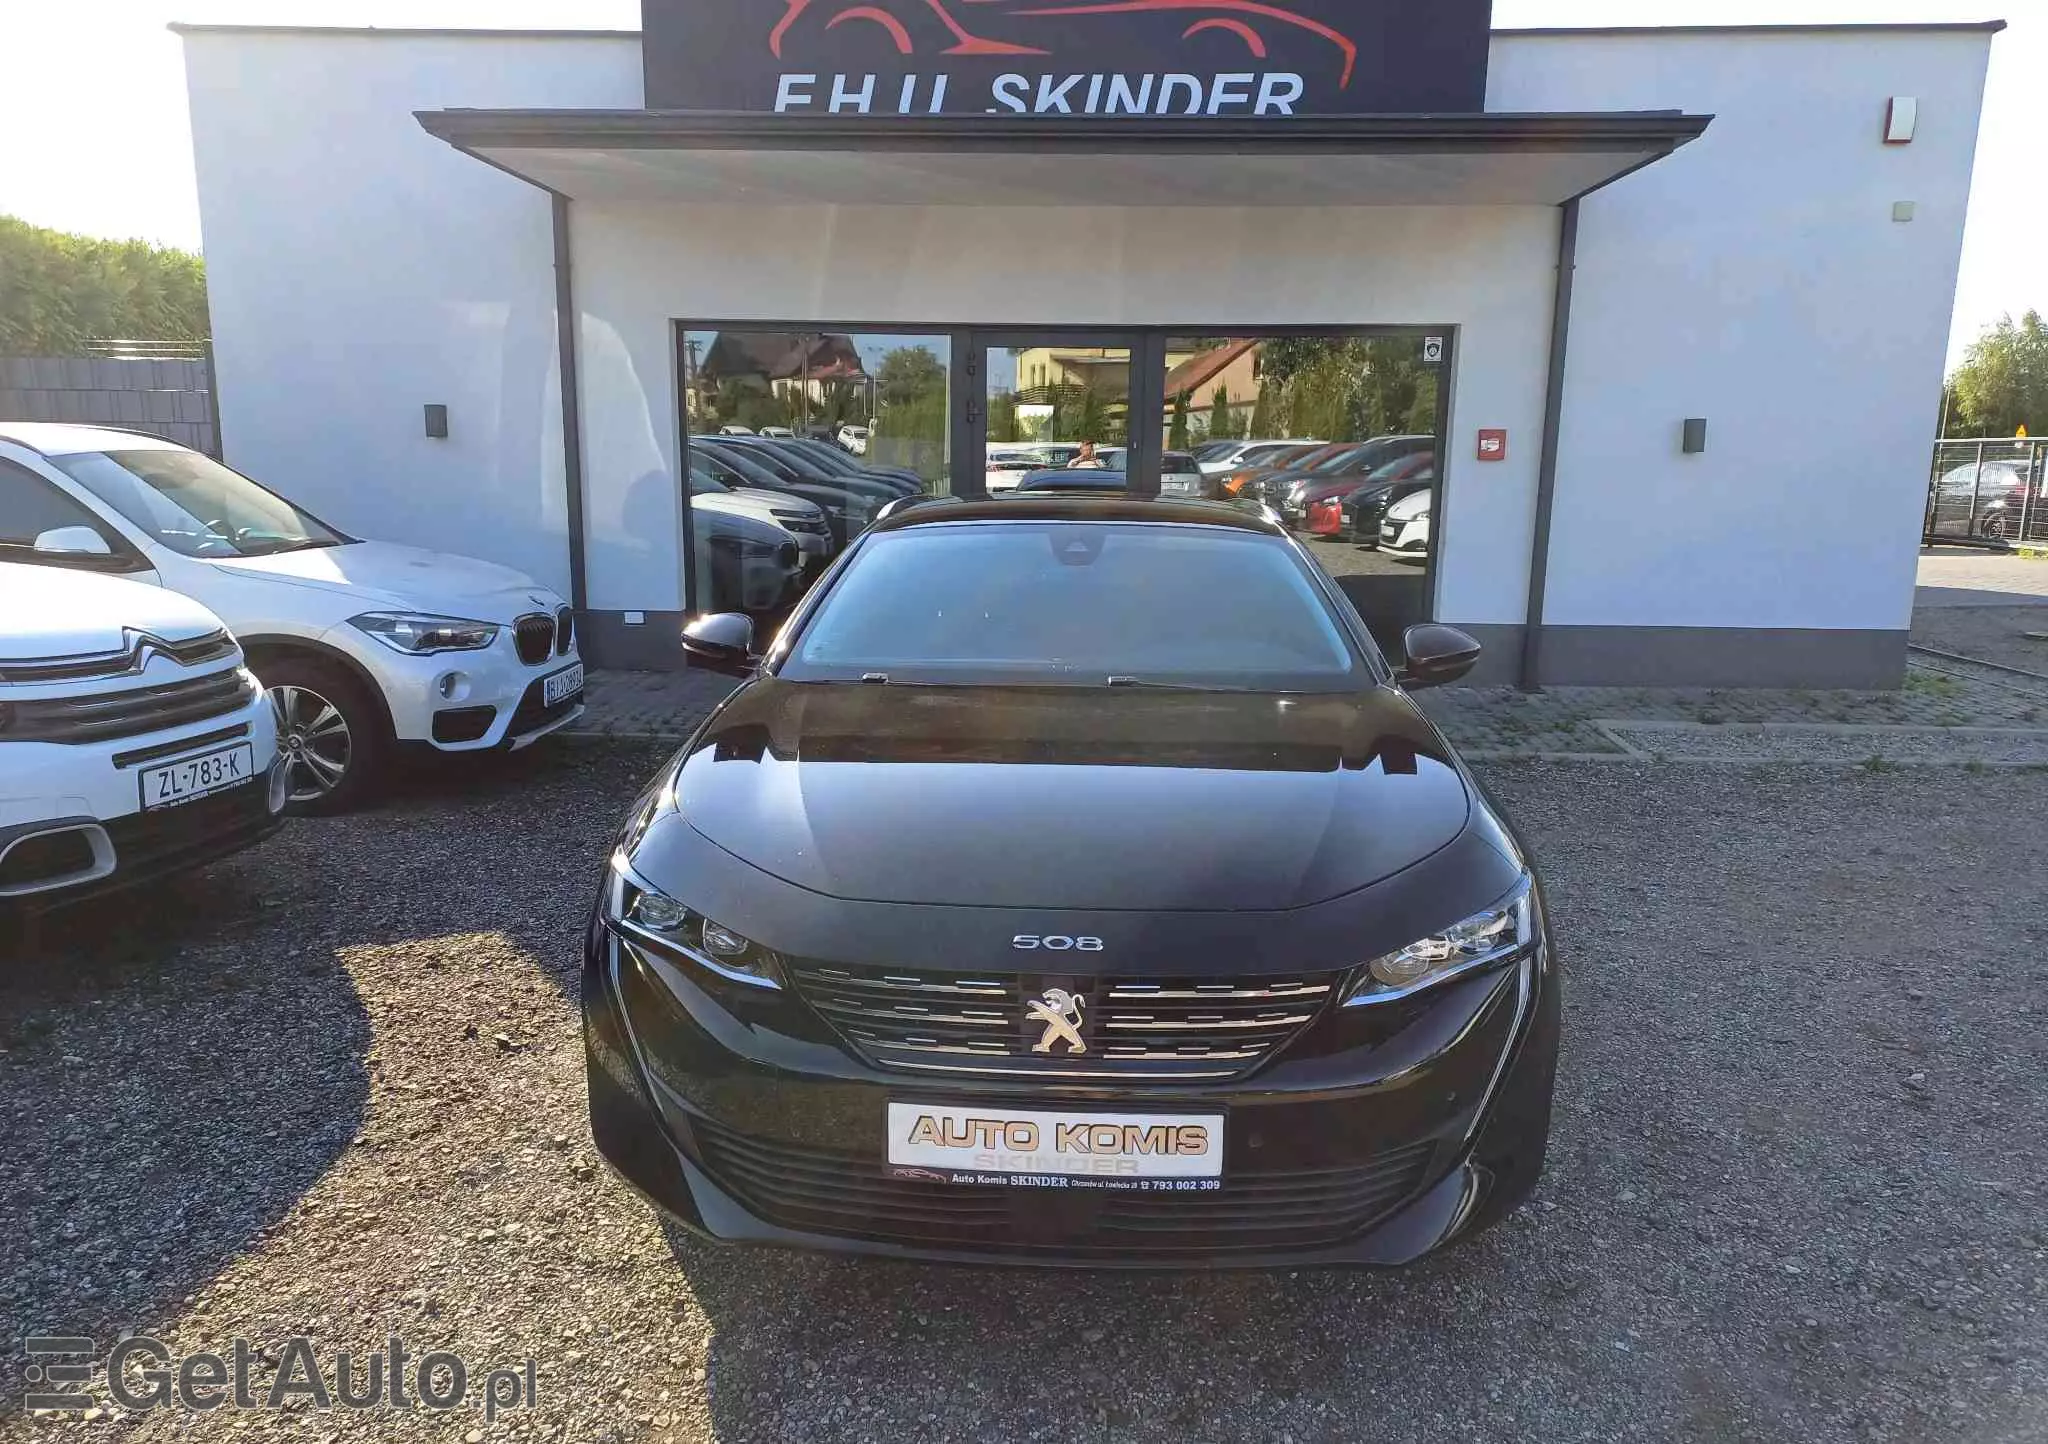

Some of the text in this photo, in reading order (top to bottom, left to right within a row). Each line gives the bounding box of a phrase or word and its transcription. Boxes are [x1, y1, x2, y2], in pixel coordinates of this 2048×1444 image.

[985, 72, 1304, 115] SKINDER
[158, 751, 240, 798] ZL-783-K
[1012, 935, 1104, 951] 508
[908, 1115, 1209, 1156] AUTO KOMIS
[974, 1154, 1139, 1174] SKINDER
[951, 1173, 975, 1184] Auto
[977, 1174, 1008, 1186] Komis
[1010, 1175, 1069, 1188] SKINDER
[1153, 1180, 1173, 1190] 793
[1176, 1180, 1196, 1191] 002
[1200, 1180, 1220, 1191] 309
